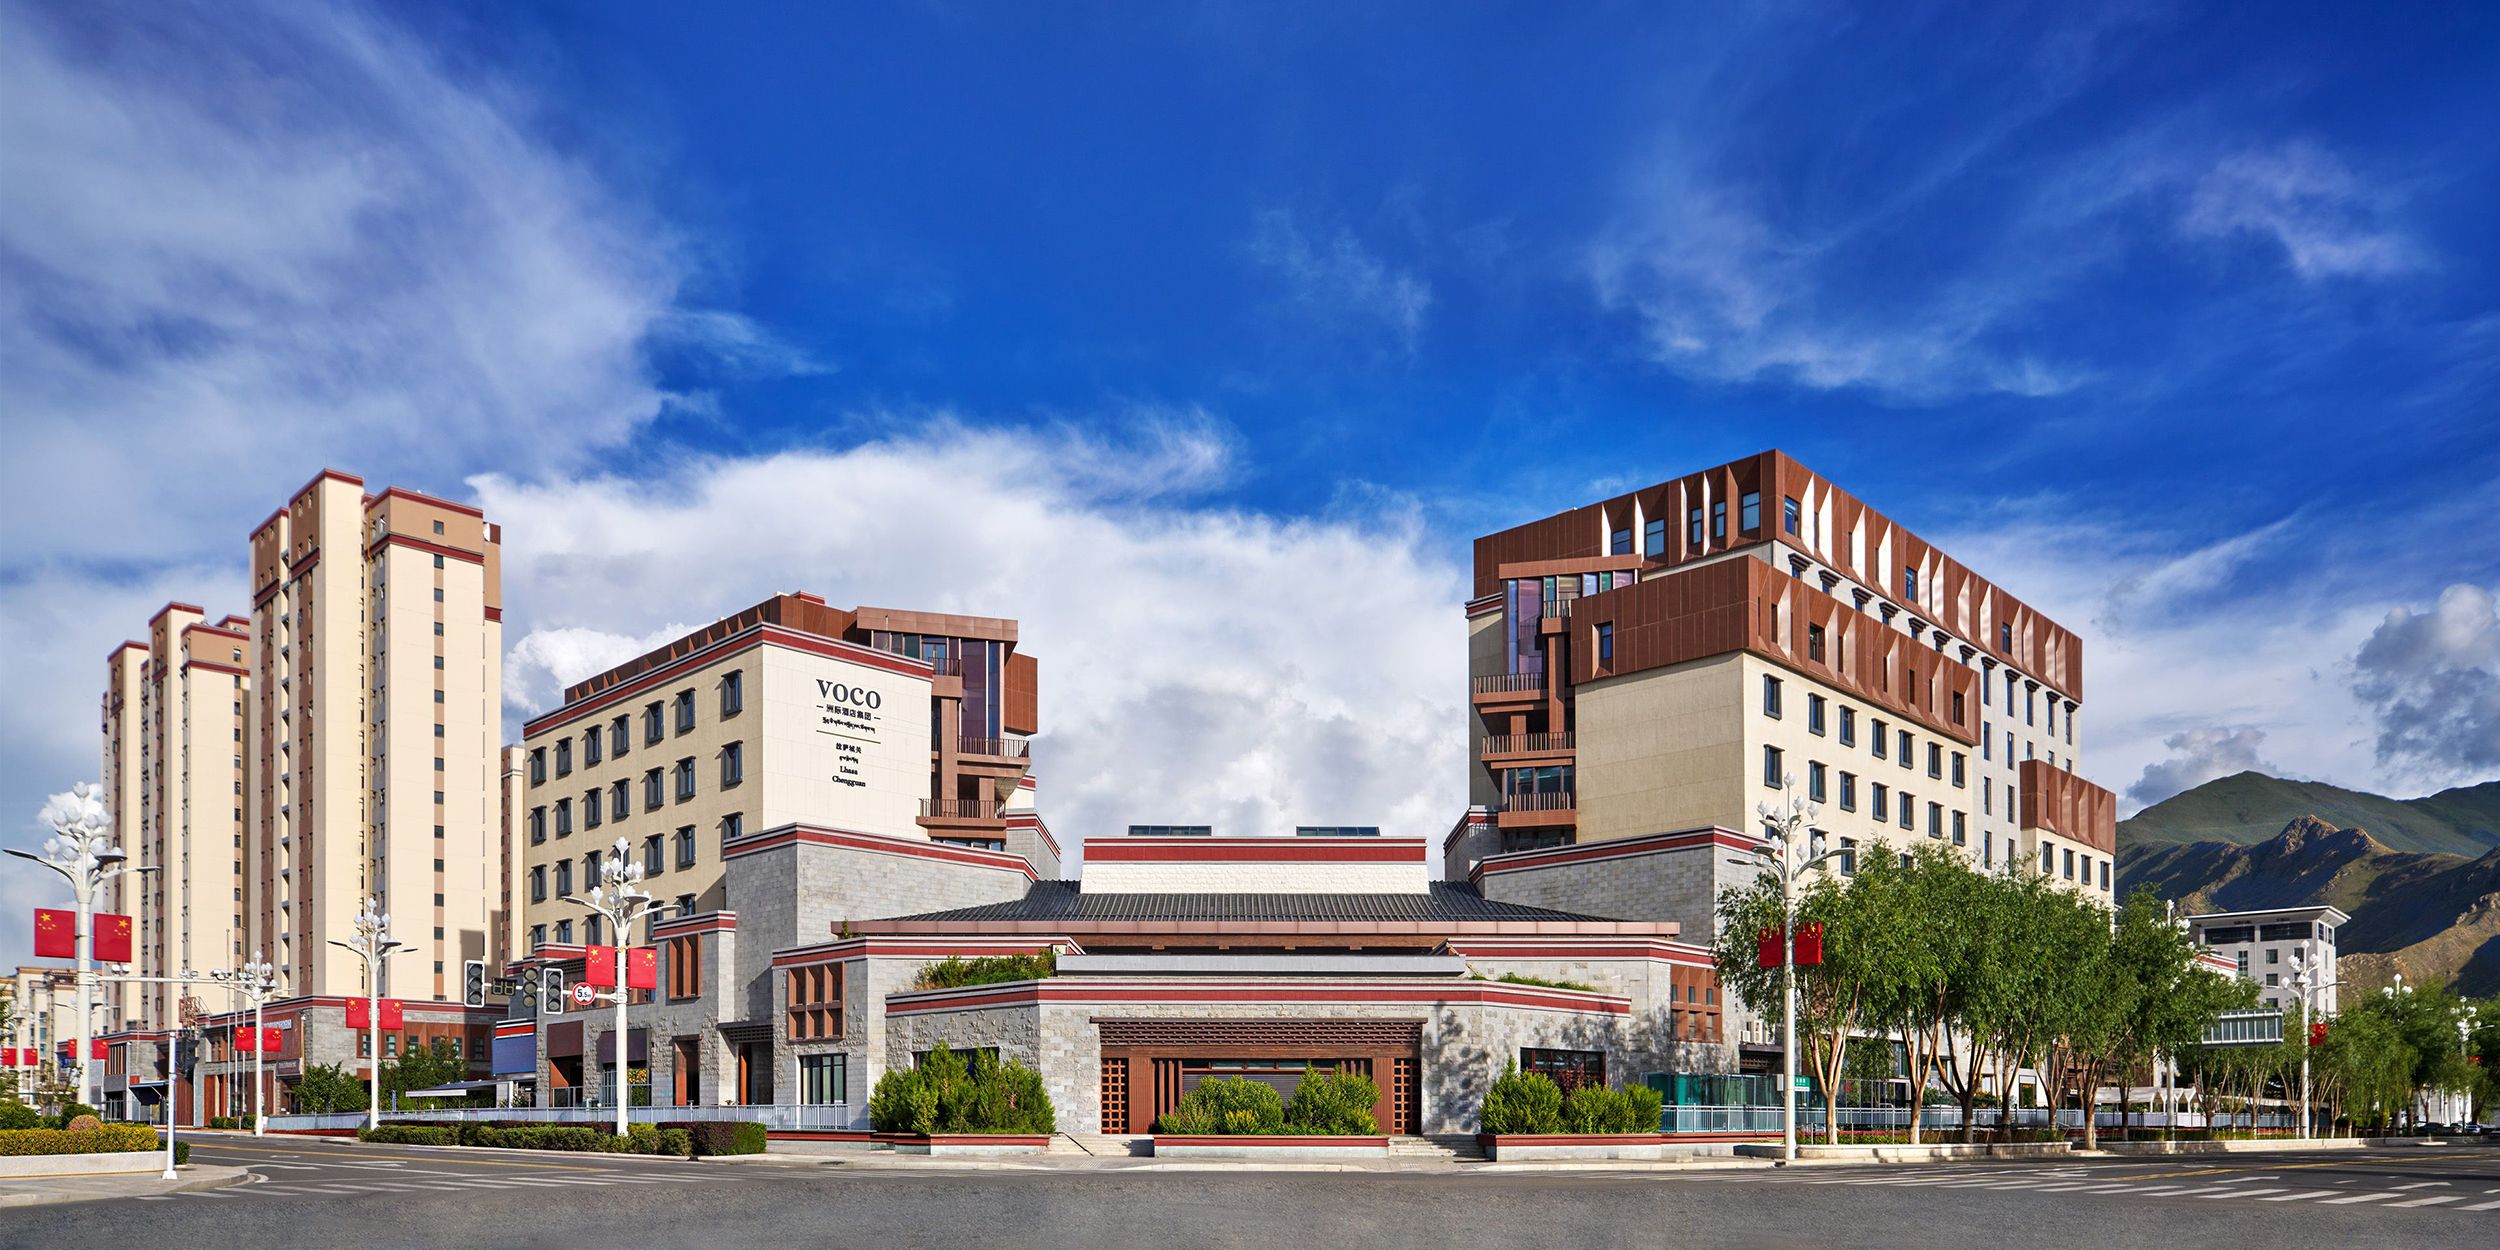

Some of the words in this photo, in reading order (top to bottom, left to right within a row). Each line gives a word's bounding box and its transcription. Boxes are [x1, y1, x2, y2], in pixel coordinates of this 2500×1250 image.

[826, 703, 872, 721] 洲际酒店集团
[831, 775, 866, 787] Chengguan
